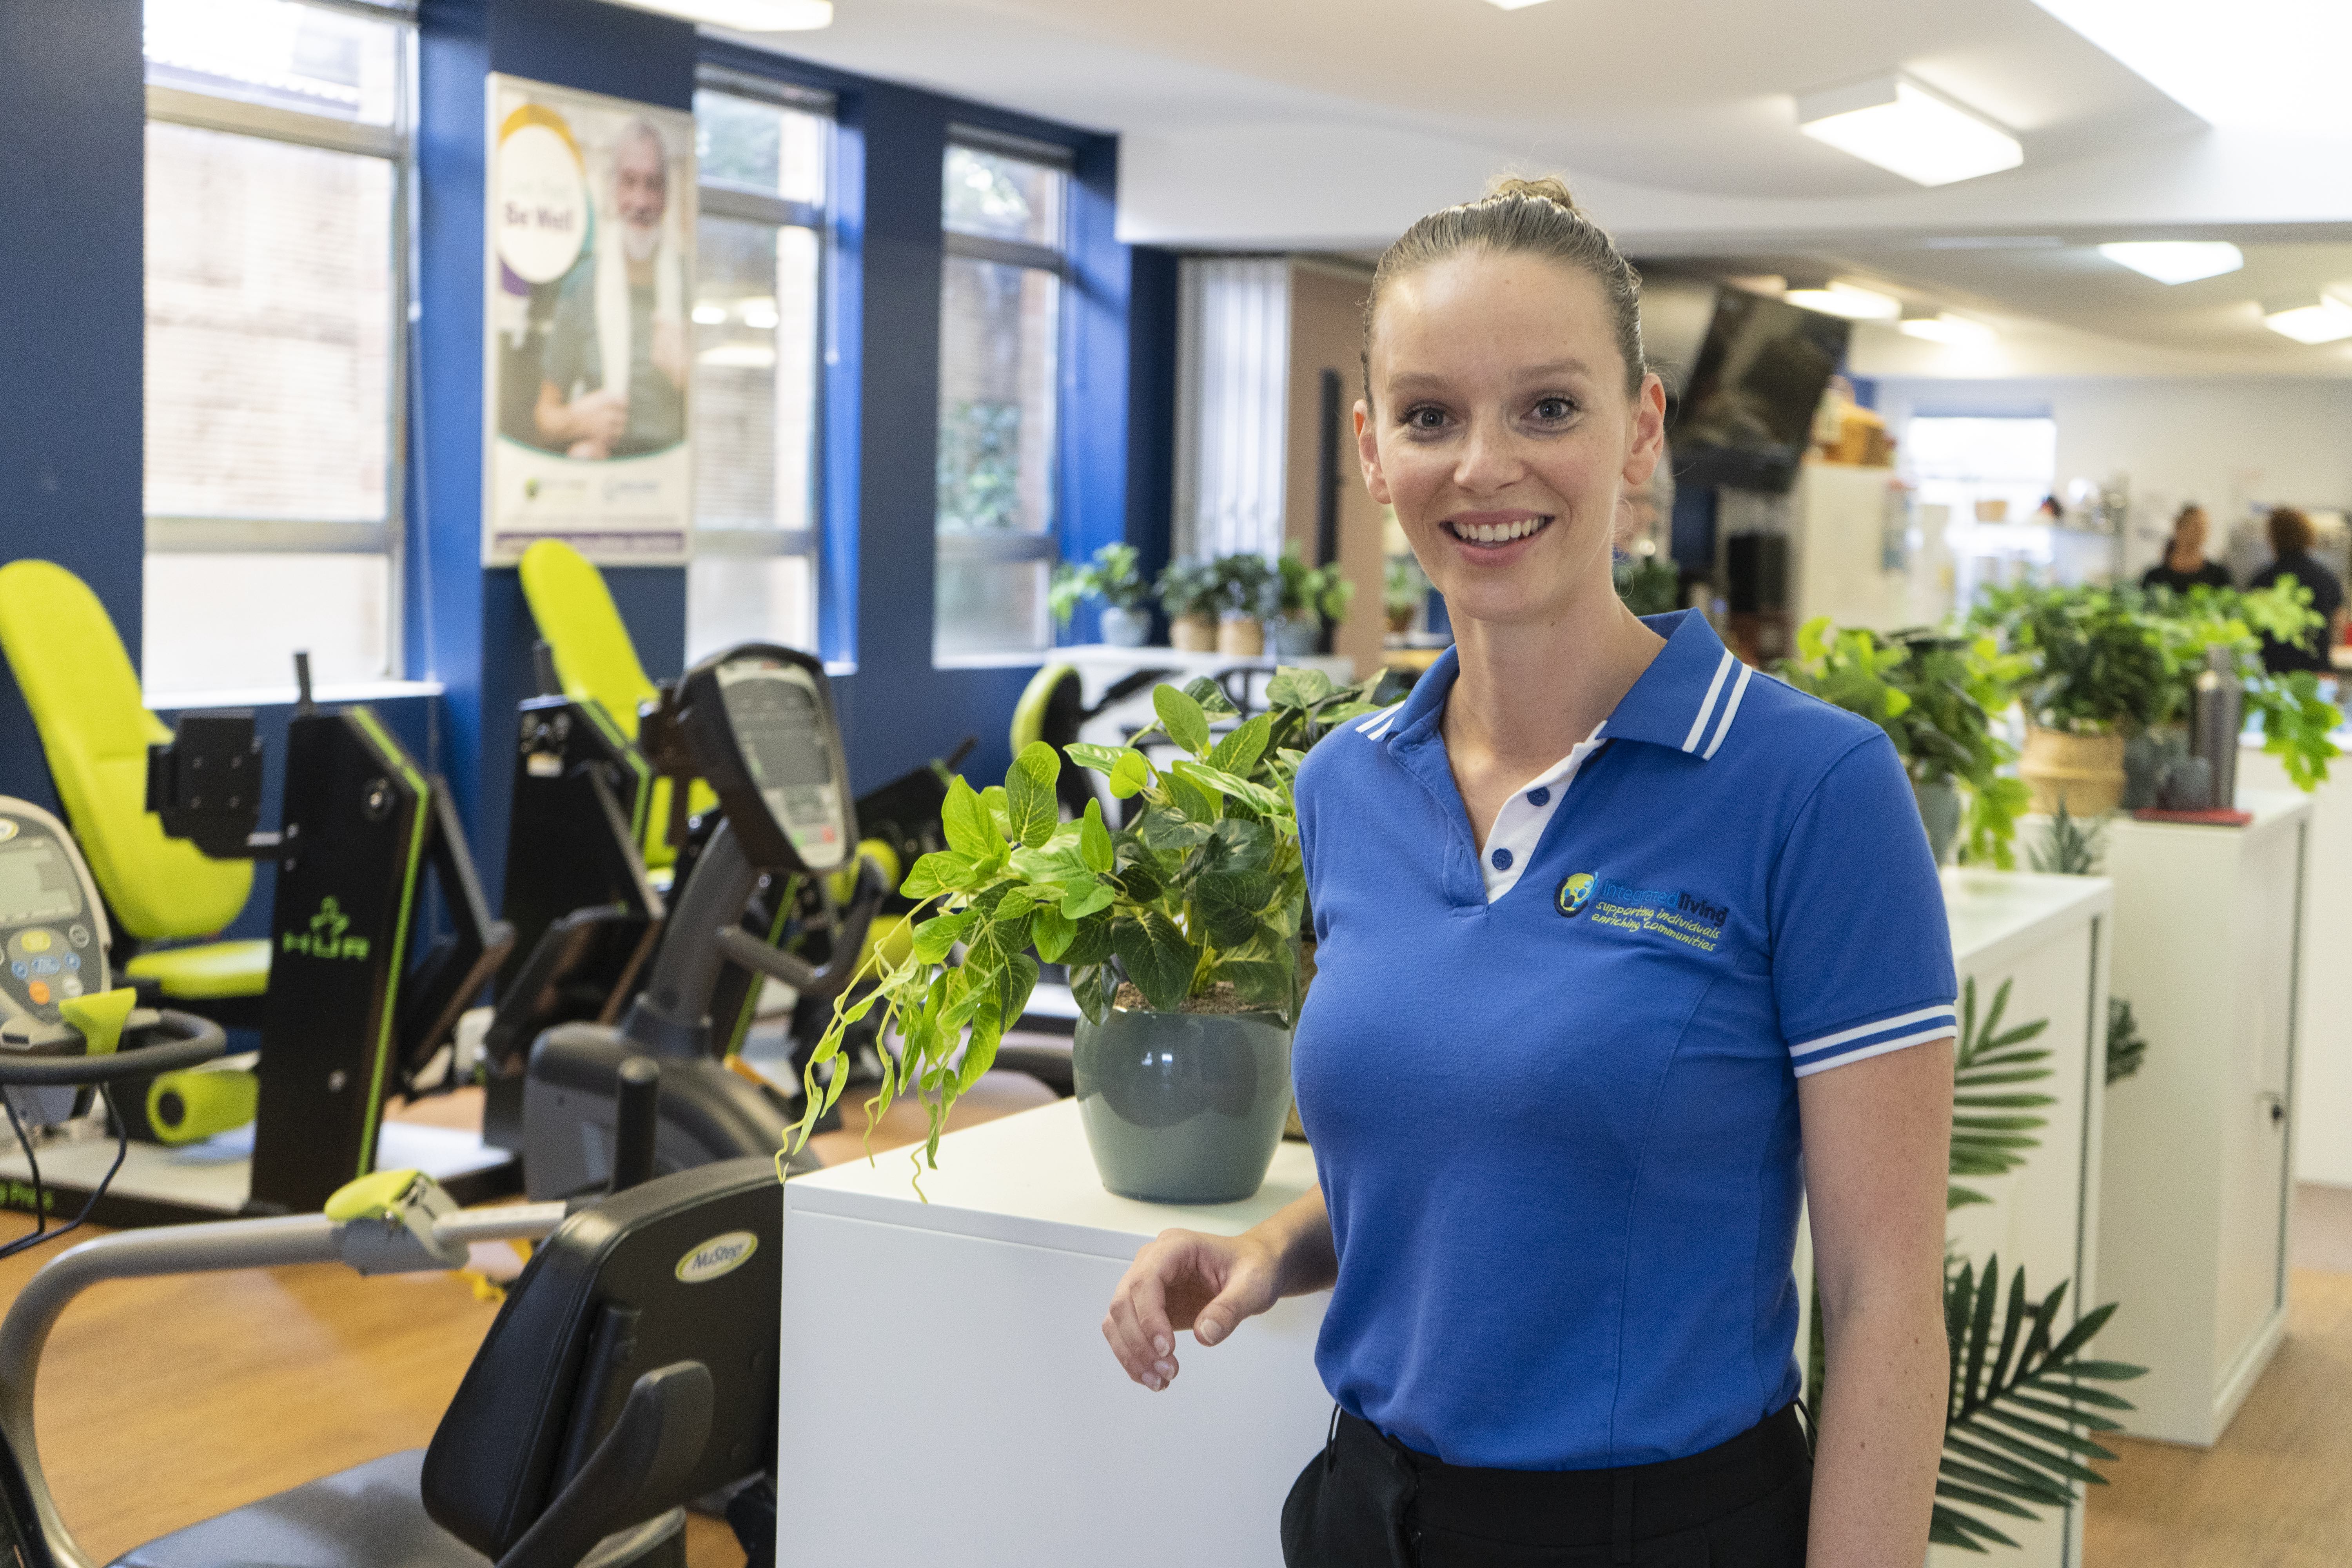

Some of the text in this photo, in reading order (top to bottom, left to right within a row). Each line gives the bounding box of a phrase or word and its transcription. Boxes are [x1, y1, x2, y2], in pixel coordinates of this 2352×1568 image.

[1592, 913, 1717, 951] enriching communities
[1595, 902, 1722, 939] supporting individuals
[282, 931, 370, 961] HUR
